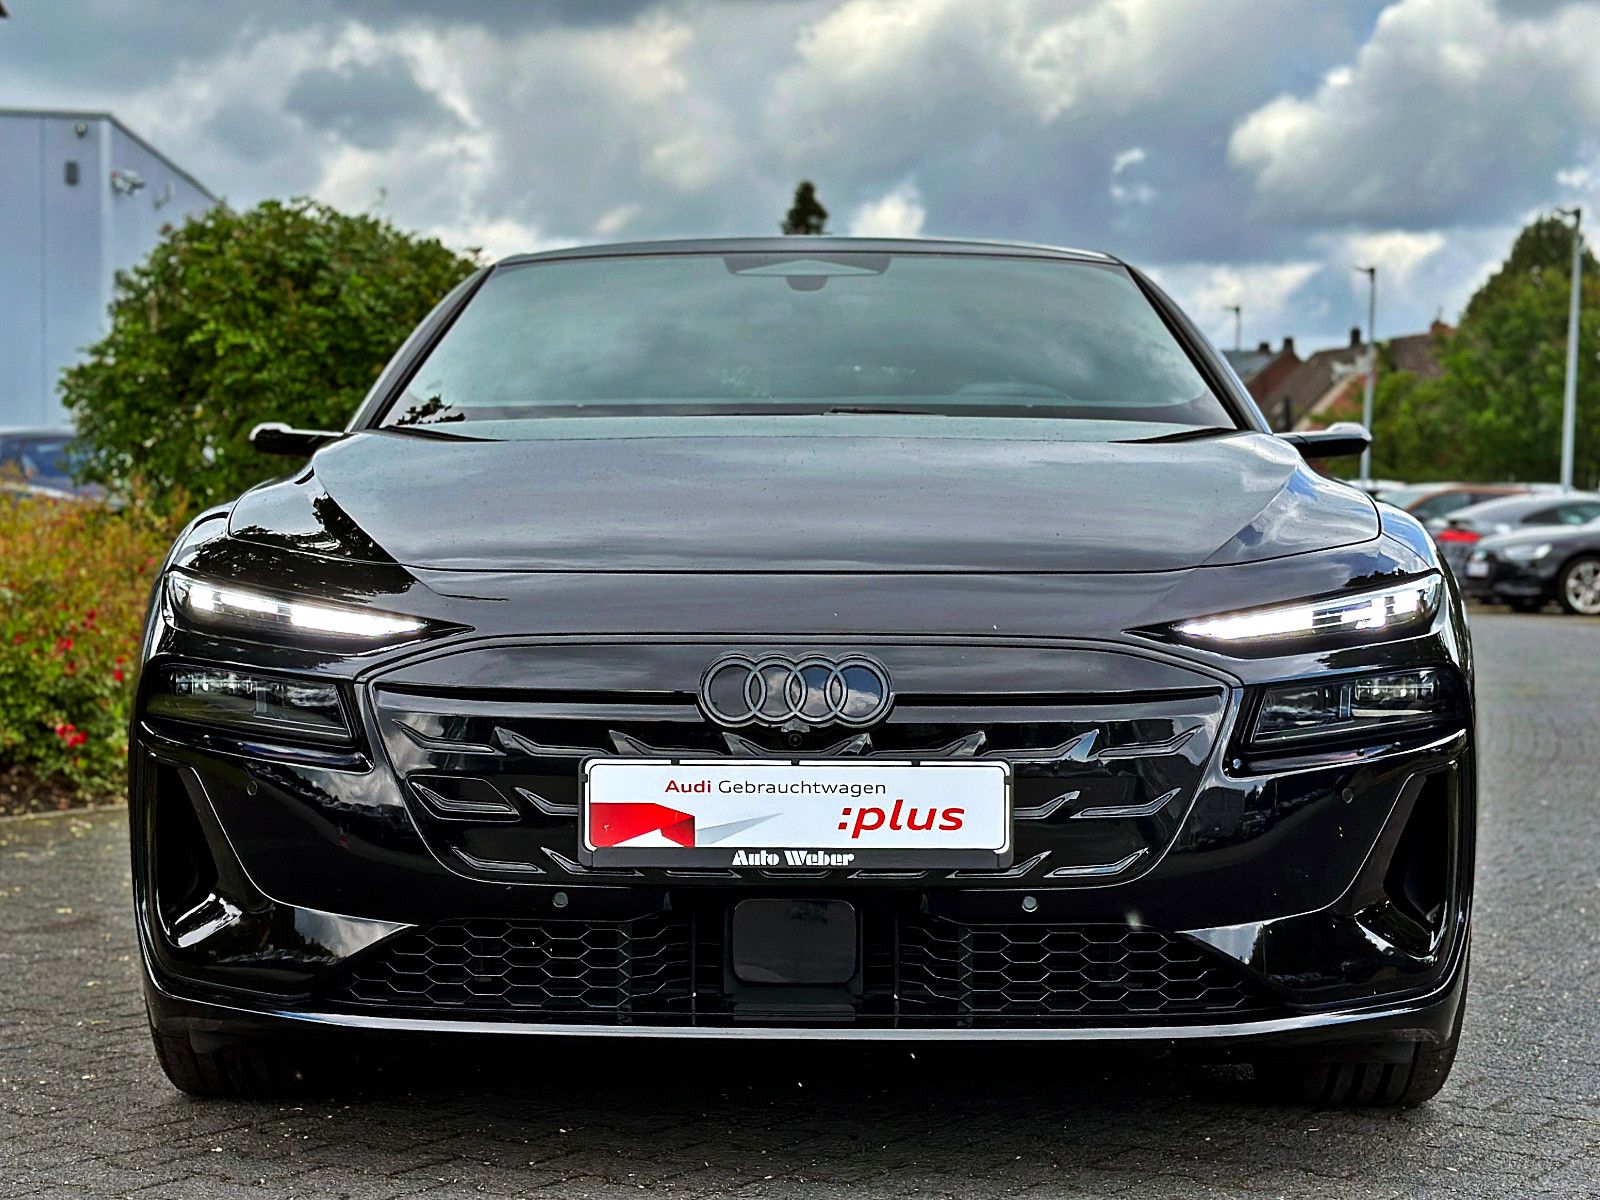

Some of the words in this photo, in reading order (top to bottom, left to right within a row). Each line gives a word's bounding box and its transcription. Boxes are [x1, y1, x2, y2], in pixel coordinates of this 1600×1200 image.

[665, 779, 711, 793] Audi
[718, 780, 886, 797] Gebrauchtwagen
[838, 799, 965, 838] :plus
[732, 849, 780, 866] Auto
[784, 850, 855, 866] Weber
